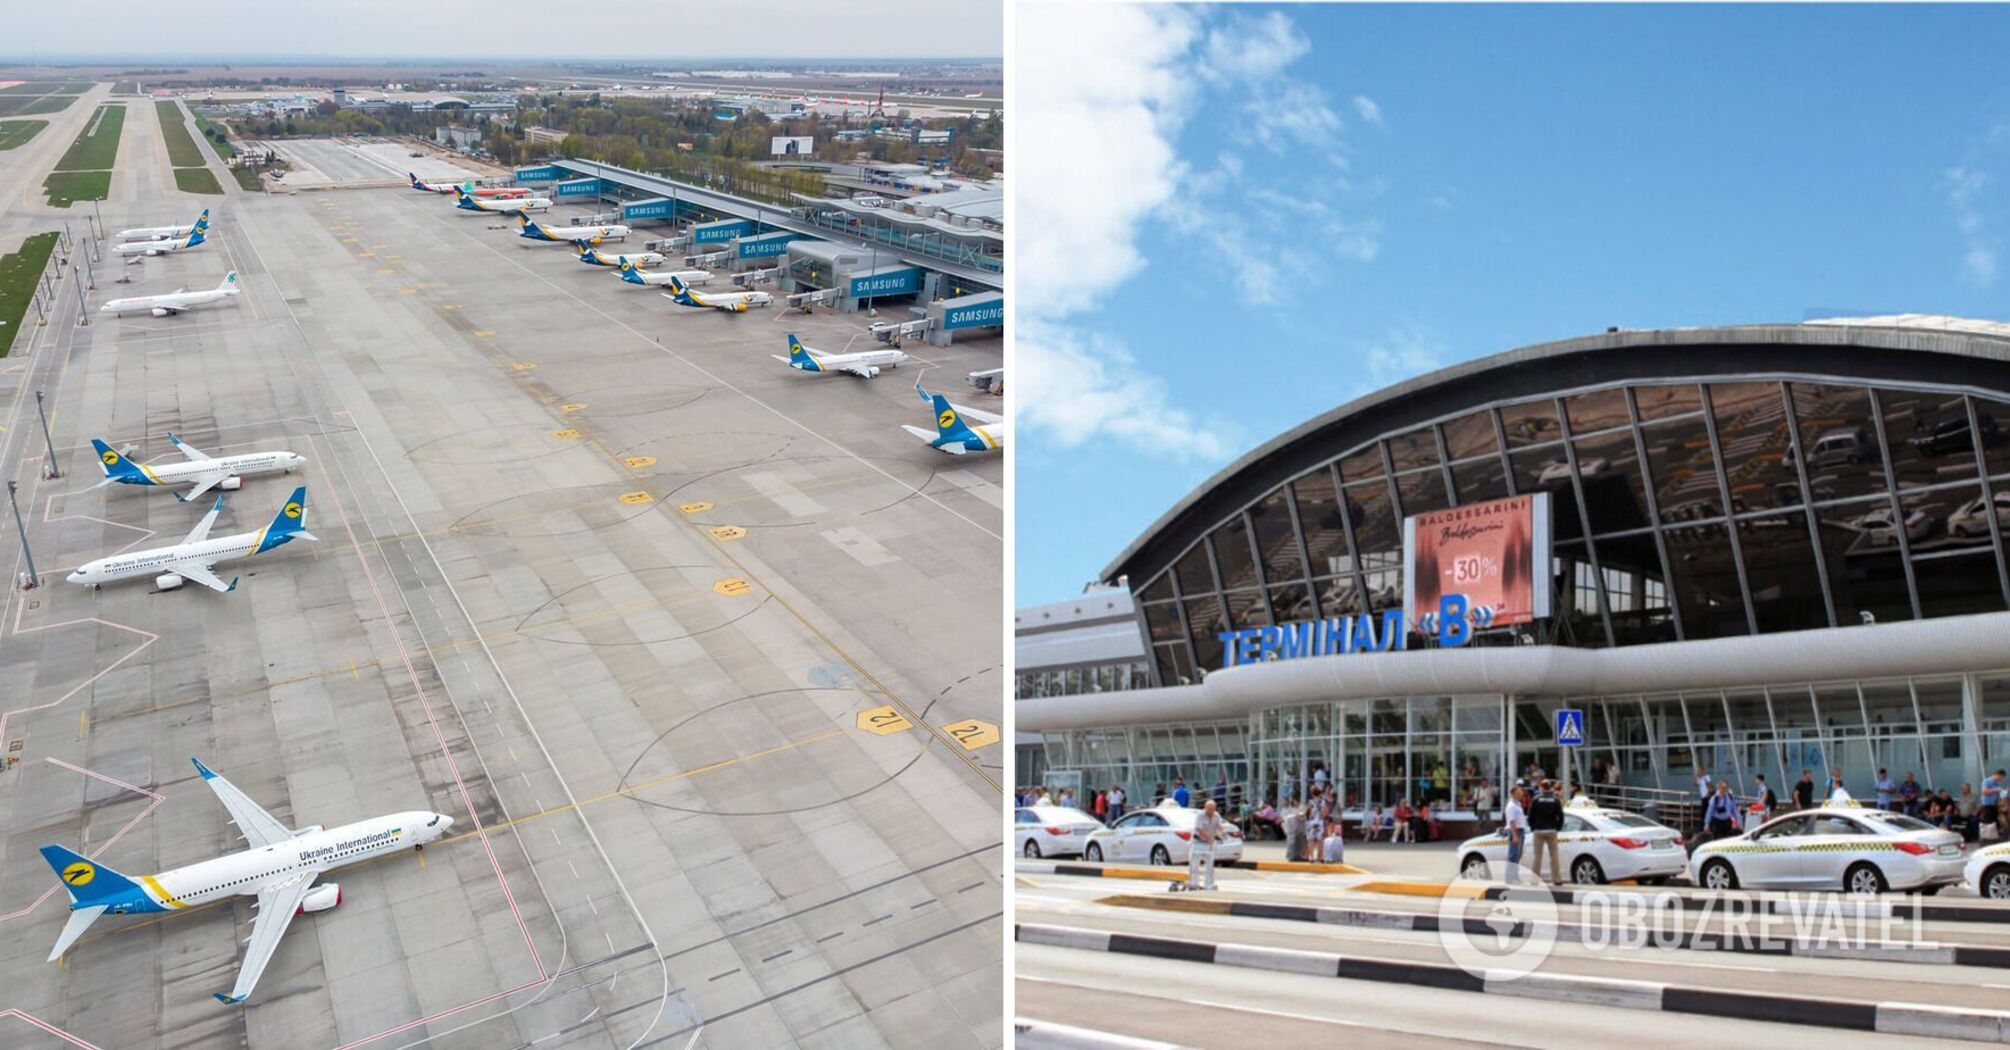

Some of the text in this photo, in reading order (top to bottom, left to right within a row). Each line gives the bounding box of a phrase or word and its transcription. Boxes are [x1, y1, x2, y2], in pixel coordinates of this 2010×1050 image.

[520, 171, 551, 179] SAMSUNG
[562, 184, 595, 193] SAMSUNG
[629, 206, 666, 216] SAMSUNG
[700, 228, 741, 240] SAMSUNG
[744, 243, 787, 255] SAMSUNG
[857, 278, 905, 292] SAMSUNG
[951, 307, 1003, 323] SAMSUNG
[1419, 500, 1526, 526] BALDESSARINI
[112, 552, 175, 568] Ukraine International
[1444, 556, 1497, 580] -30%
[1218, 609, 1407, 668] ТЕРМІНАЛ
[299, 845, 335, 861] Ukraine
[336, 829, 391, 851] International
